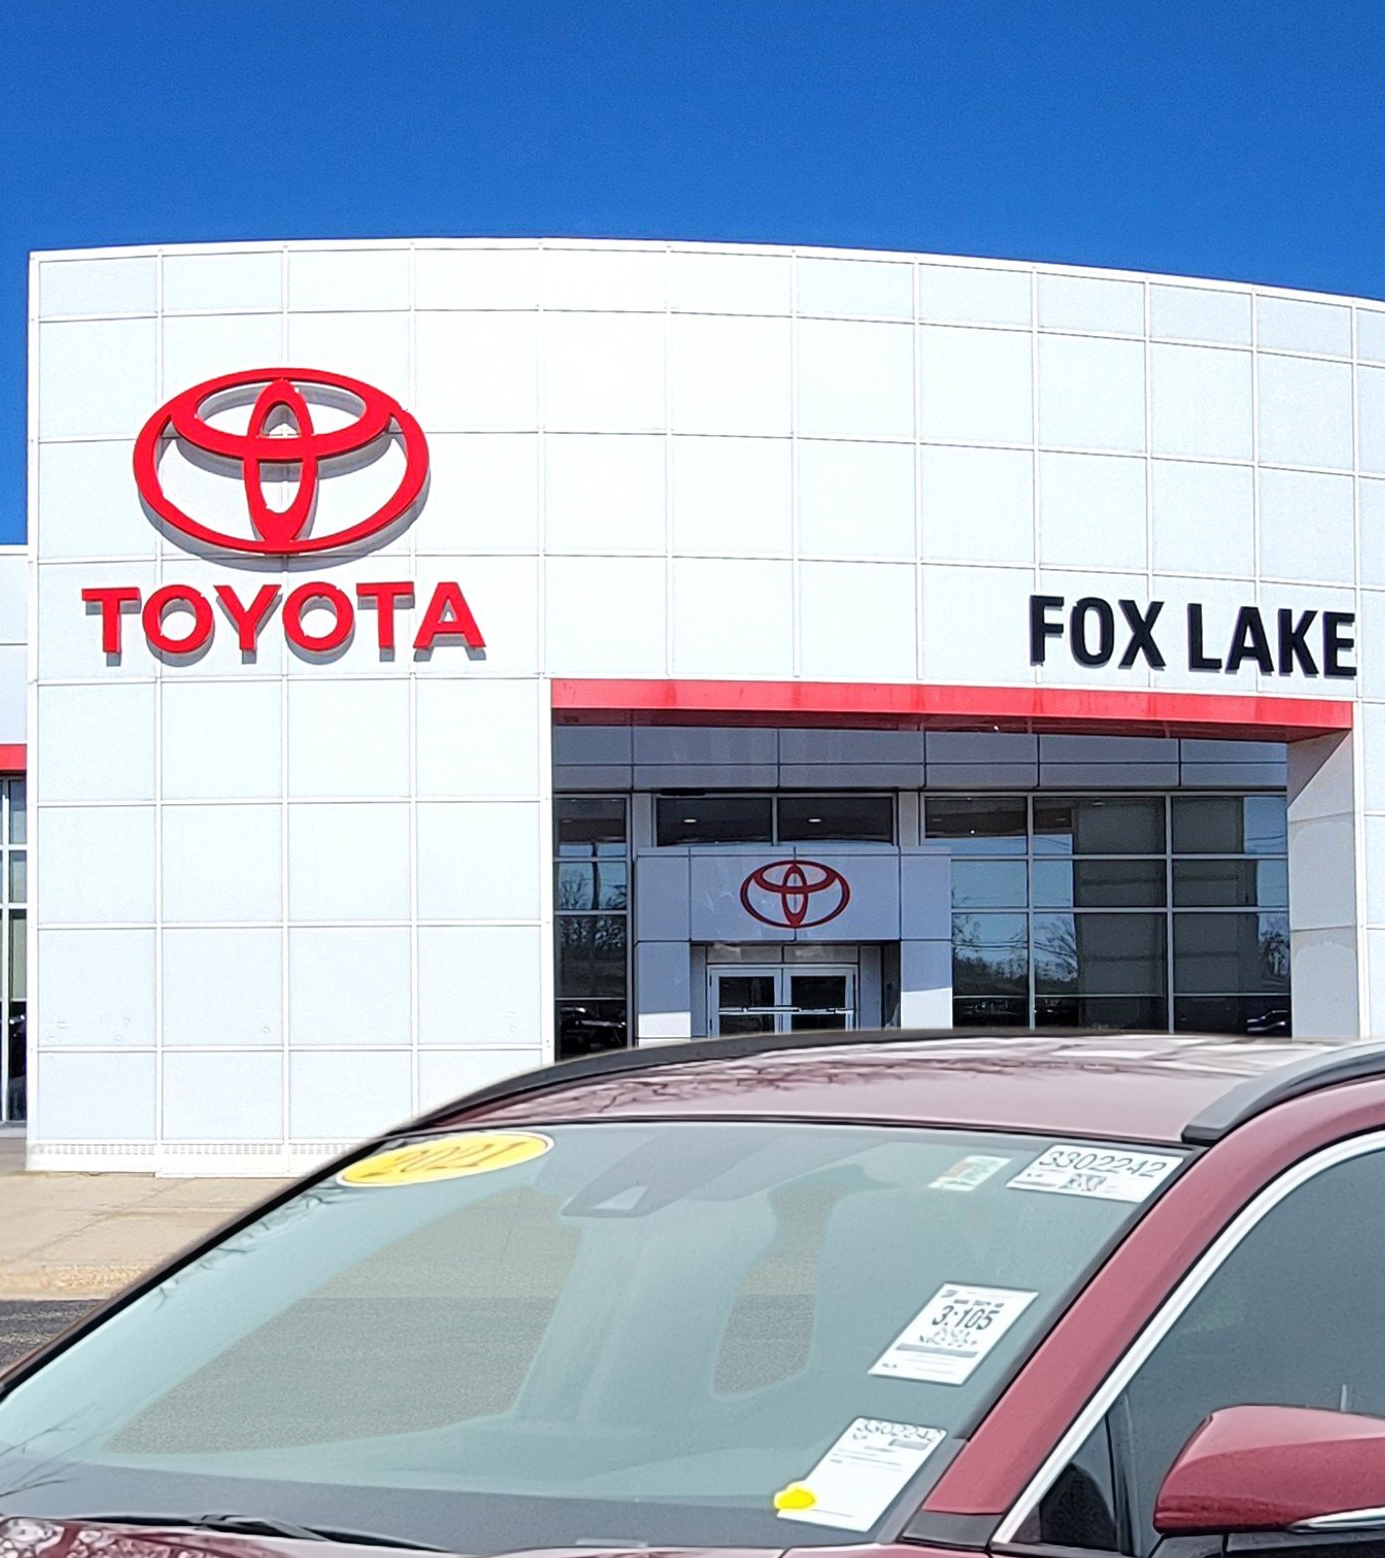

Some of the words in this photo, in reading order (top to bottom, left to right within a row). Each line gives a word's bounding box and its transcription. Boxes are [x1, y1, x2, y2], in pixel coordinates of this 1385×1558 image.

[81, 581, 487, 662] TOYOTA
[1029, 594, 1167, 670] FOX
[1187, 602, 1358, 679] LAKE
